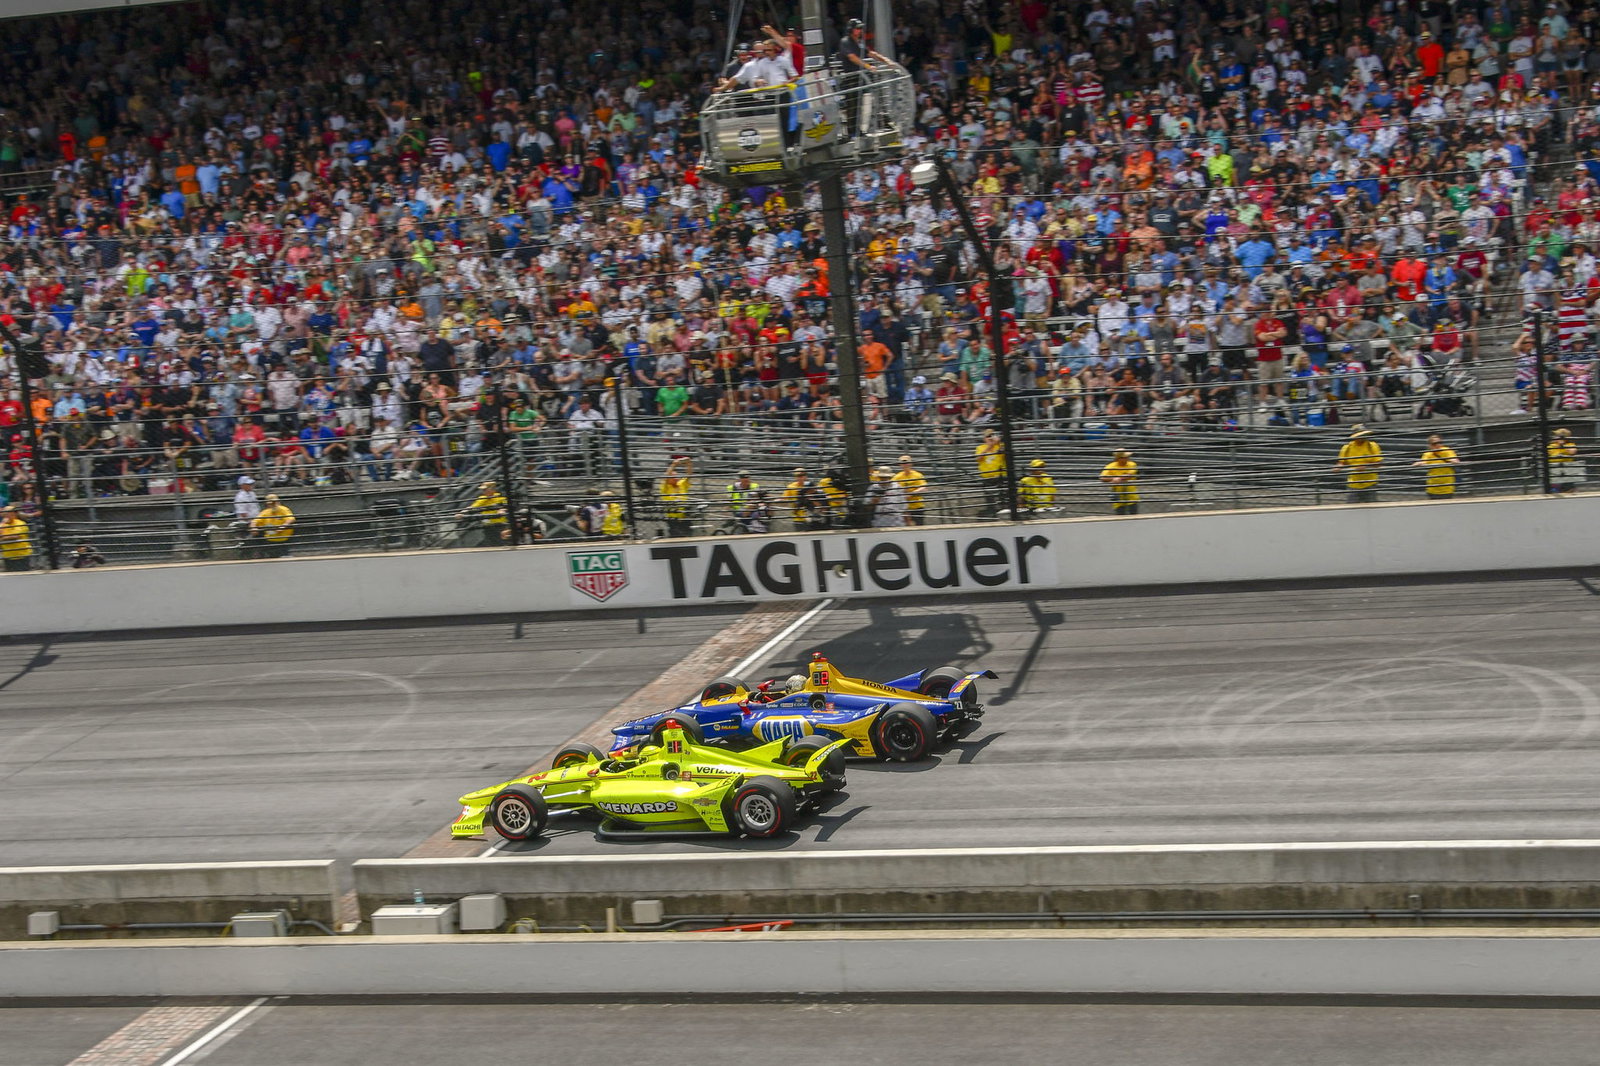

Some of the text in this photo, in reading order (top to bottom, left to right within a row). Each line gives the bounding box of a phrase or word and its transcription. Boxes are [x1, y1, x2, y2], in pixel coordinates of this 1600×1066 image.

[572, 555, 621, 571] TAG
[573, 574, 625, 595] HEUER
[862, 680, 898, 693] HONDA
[761, 720, 804, 744] NAPA
[598, 800, 678, 814] MENARDS
[453, 824, 481, 832] HITACHI
